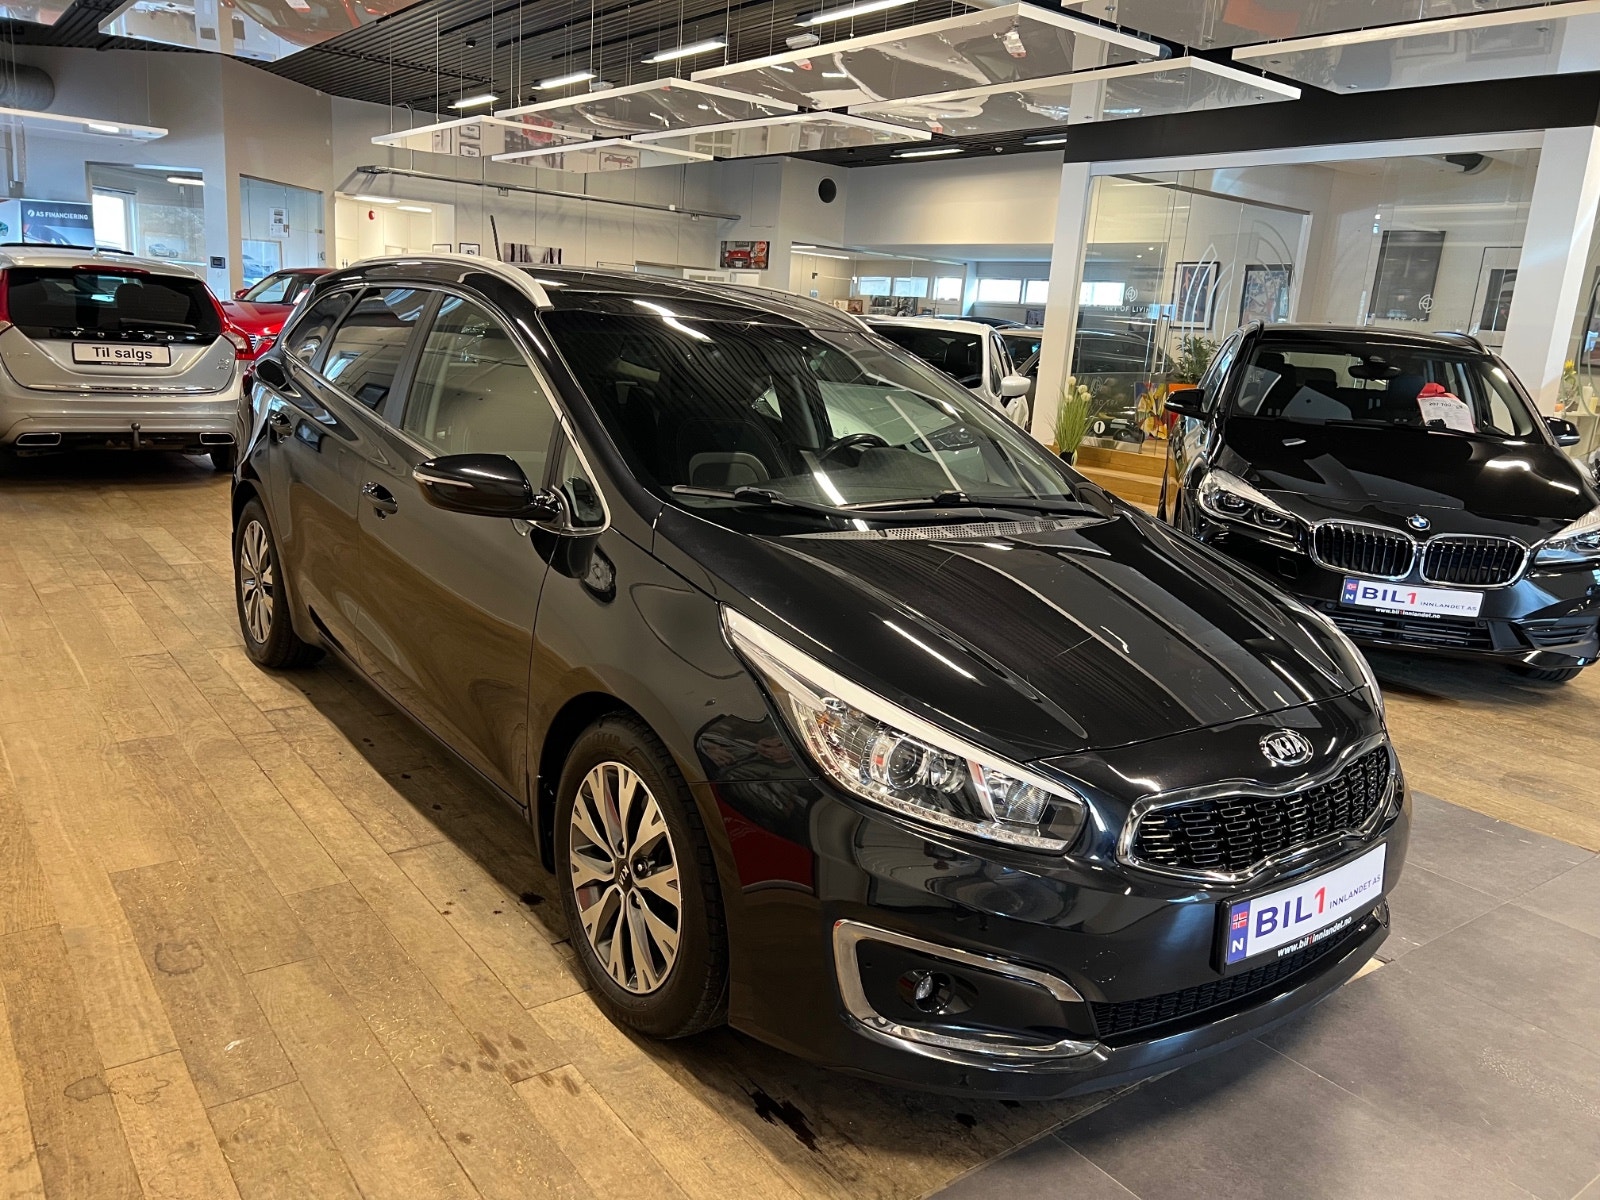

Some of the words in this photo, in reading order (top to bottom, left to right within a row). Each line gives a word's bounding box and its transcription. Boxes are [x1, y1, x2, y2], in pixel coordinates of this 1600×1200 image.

[45, 212, 89, 220] FINANCIERING
[92, 346, 110, 358] Til
[114, 348, 153, 361] salgs
[1375, 607, 1441, 619] www.bil1innlandet.no
[1420, 601, 1465, 610] INNLANDET
[1267, 734, 1307, 760] KIA
[618, 864, 630, 886] KIA
[1231, 938, 1244, 954] N
[1329, 880, 1372, 909] INNLANDET
[1372, 875, 1381, 886] AS
[1277, 916, 1352, 958] www.bil1innlandet.no
